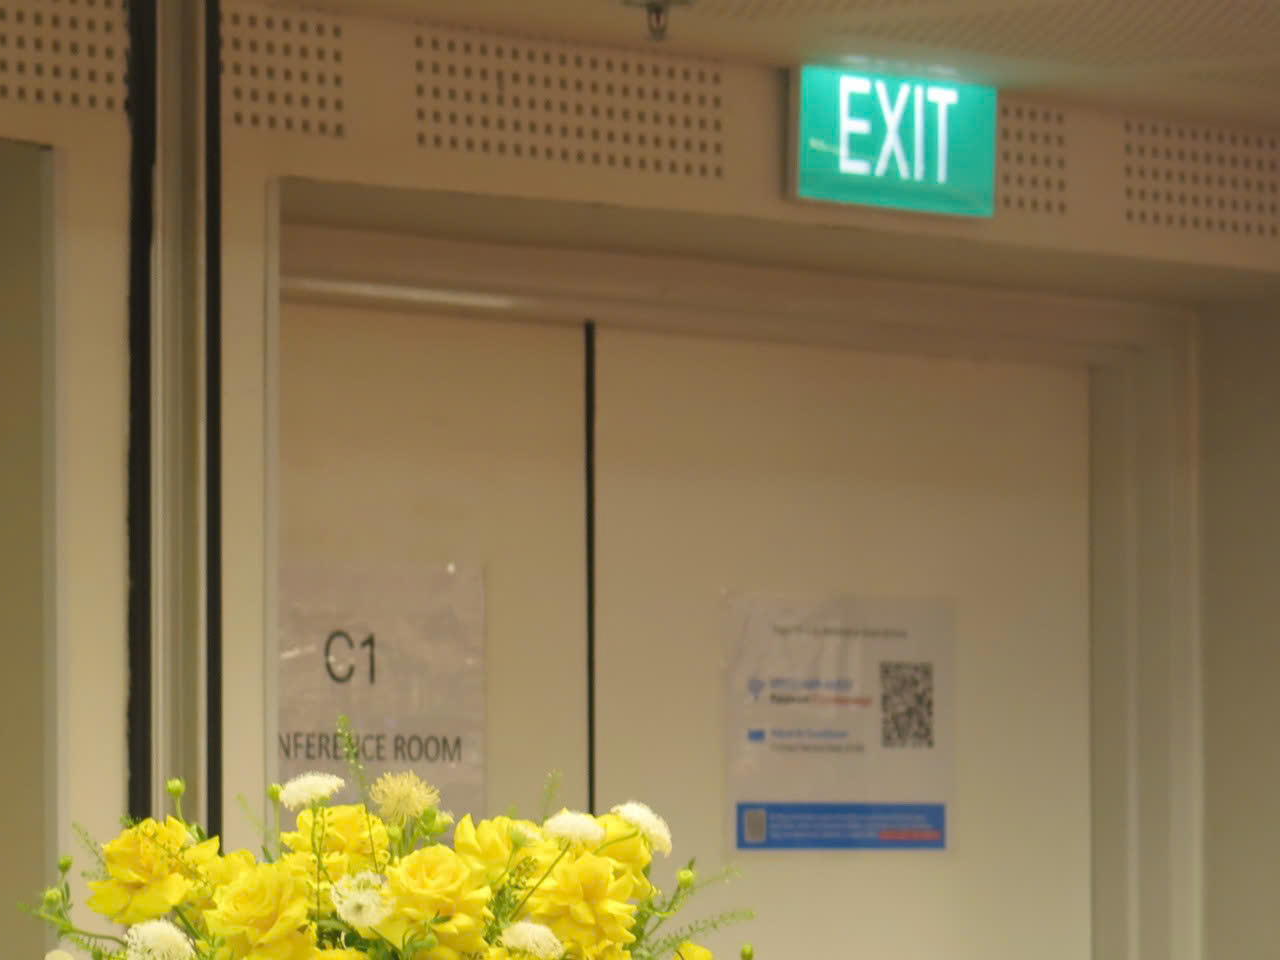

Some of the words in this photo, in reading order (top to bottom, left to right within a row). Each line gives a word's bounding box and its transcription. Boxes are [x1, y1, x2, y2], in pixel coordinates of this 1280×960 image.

[839, 74, 959, 185] EXIT
[324, 629, 376, 685] C1
[394, 734, 463, 763] ROOM
